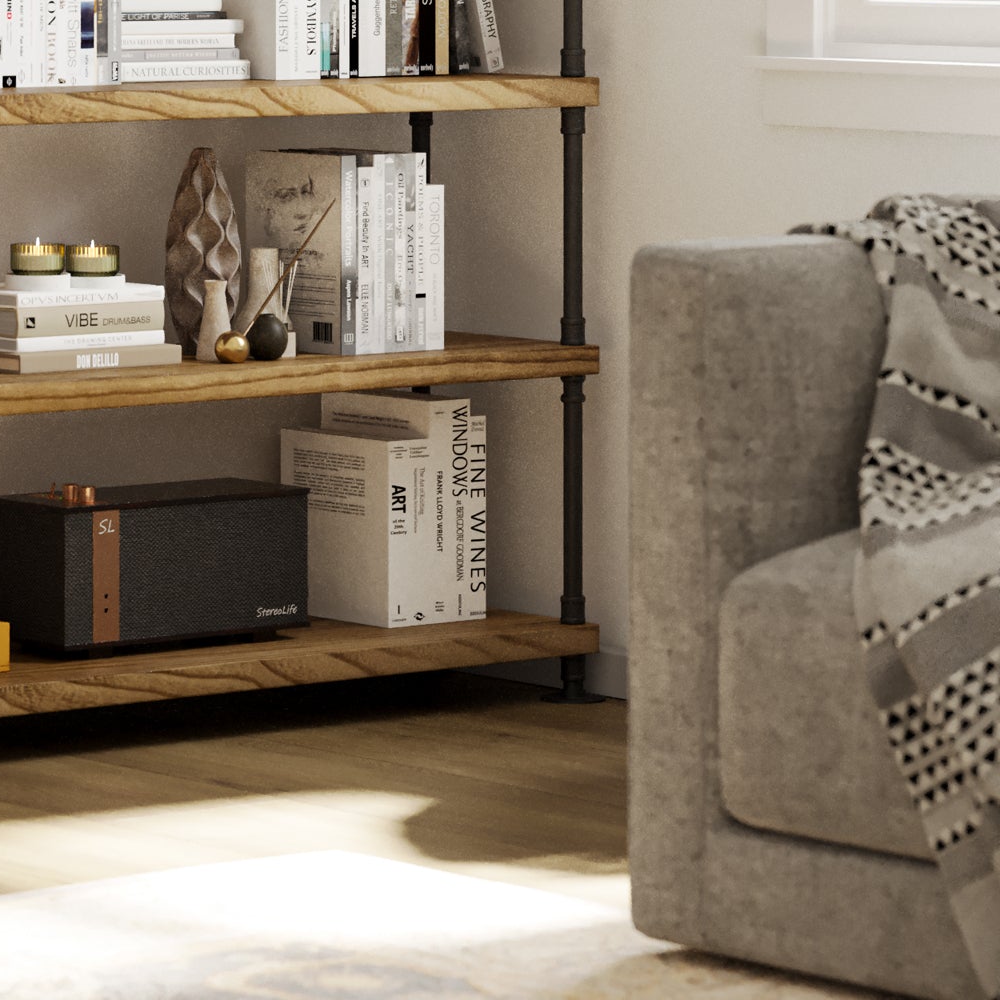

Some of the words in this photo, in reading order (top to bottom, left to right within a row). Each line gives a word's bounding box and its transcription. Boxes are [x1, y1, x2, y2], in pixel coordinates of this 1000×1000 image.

[47, 32, 56, 83] BOOK
[68, 19, 80, 68] Snaps
[131, 66, 181, 77] NATURAL
[182, 65, 247, 76] CURIOSITIES
[344, 170, 353, 223] Watercolor
[344, 225, 353, 267] Portraits
[361, 218, 369, 243] Beauty
[429, 195, 440, 265] TORONTO
[362, 245, 369, 253] In
[361, 283, 369, 300] ELLE
[65, 312, 99, 328] VIBE
[102, 316, 151, 327] DRUM&BASS
[361, 301, 369, 335] NORMAN
[76, 354, 92, 369] DON
[93, 352, 119, 367] DELILLO
[452, 405, 468, 497] WINDOWS
[470, 444, 486, 498] FINE
[392, 484, 407, 514] ART
[98, 518, 116, 535] SL
[456, 544, 464, 582] GOODMAN
[470, 510, 486, 593] WINES
[256, 603, 298, 618] StereoLife
